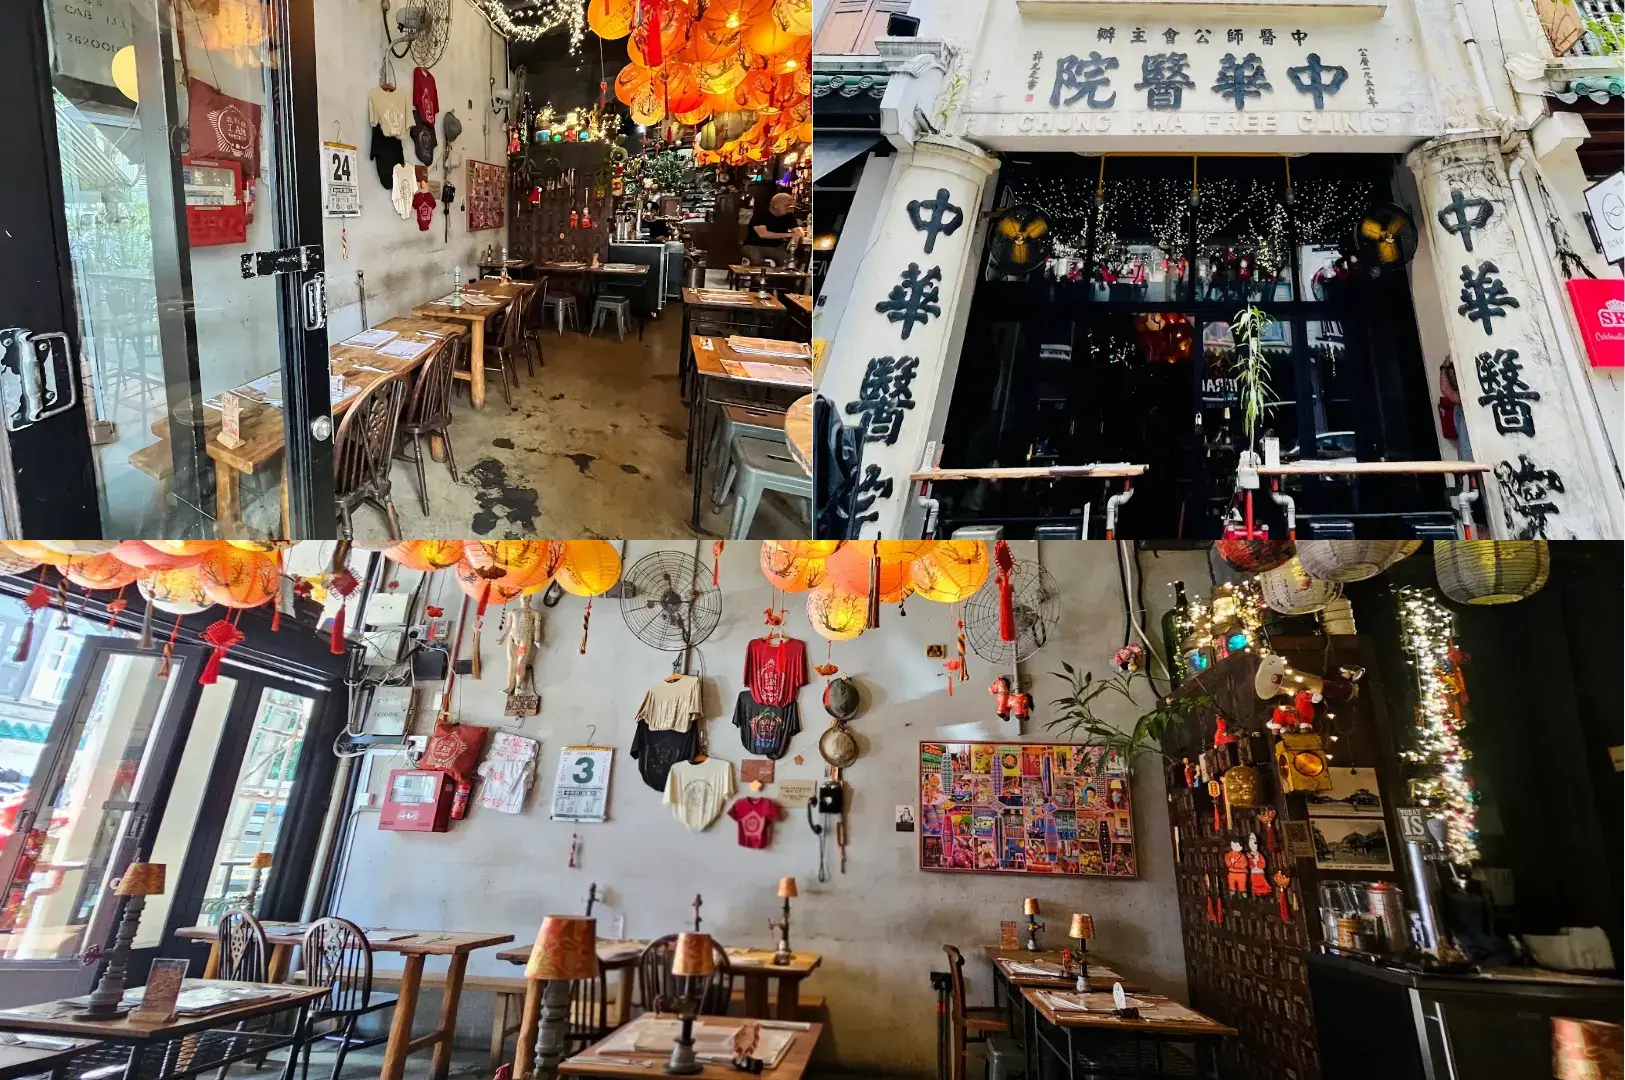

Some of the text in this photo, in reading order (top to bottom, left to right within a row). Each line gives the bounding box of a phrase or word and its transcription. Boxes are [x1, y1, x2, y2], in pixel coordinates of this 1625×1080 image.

[1018, 113, 1390, 134] CHUNG HWA FREE CLINIC
[332, 153, 351, 181] 24
[572, 757, 595, 784] 3
[1399, 808, 1421, 816] TODAY
[1401, 816, 1425, 836] IS
